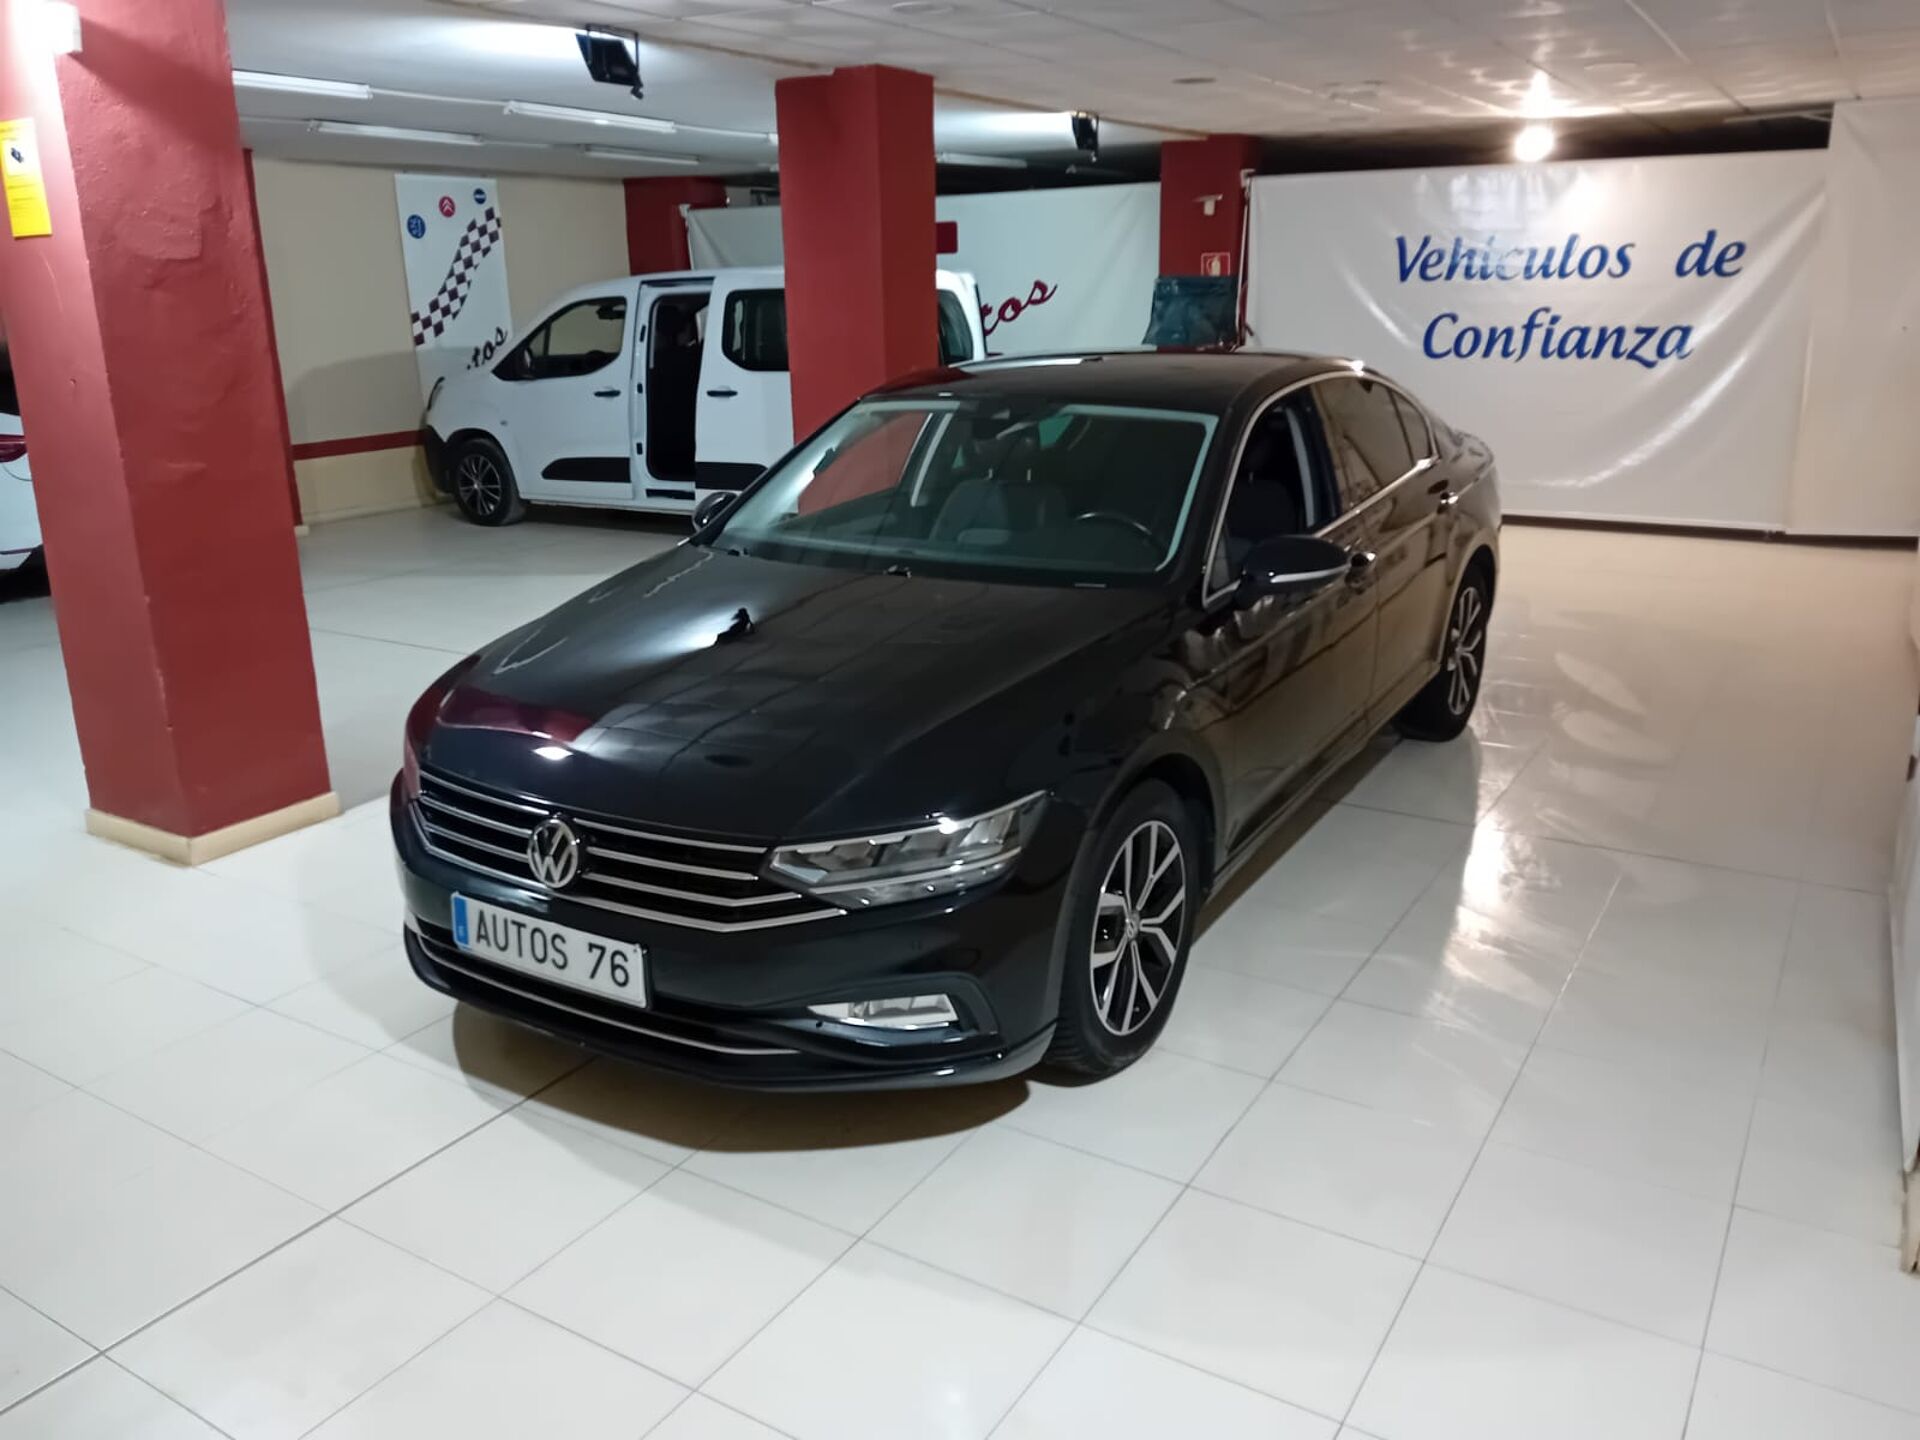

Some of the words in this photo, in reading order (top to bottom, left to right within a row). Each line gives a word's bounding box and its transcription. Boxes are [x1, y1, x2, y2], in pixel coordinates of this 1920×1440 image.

[1675, 229, 1748, 279] de
[1422, 306, 1695, 370] Confianza
[475, 908, 570, 972] AUTOS
[587, 941, 631, 989] 76
